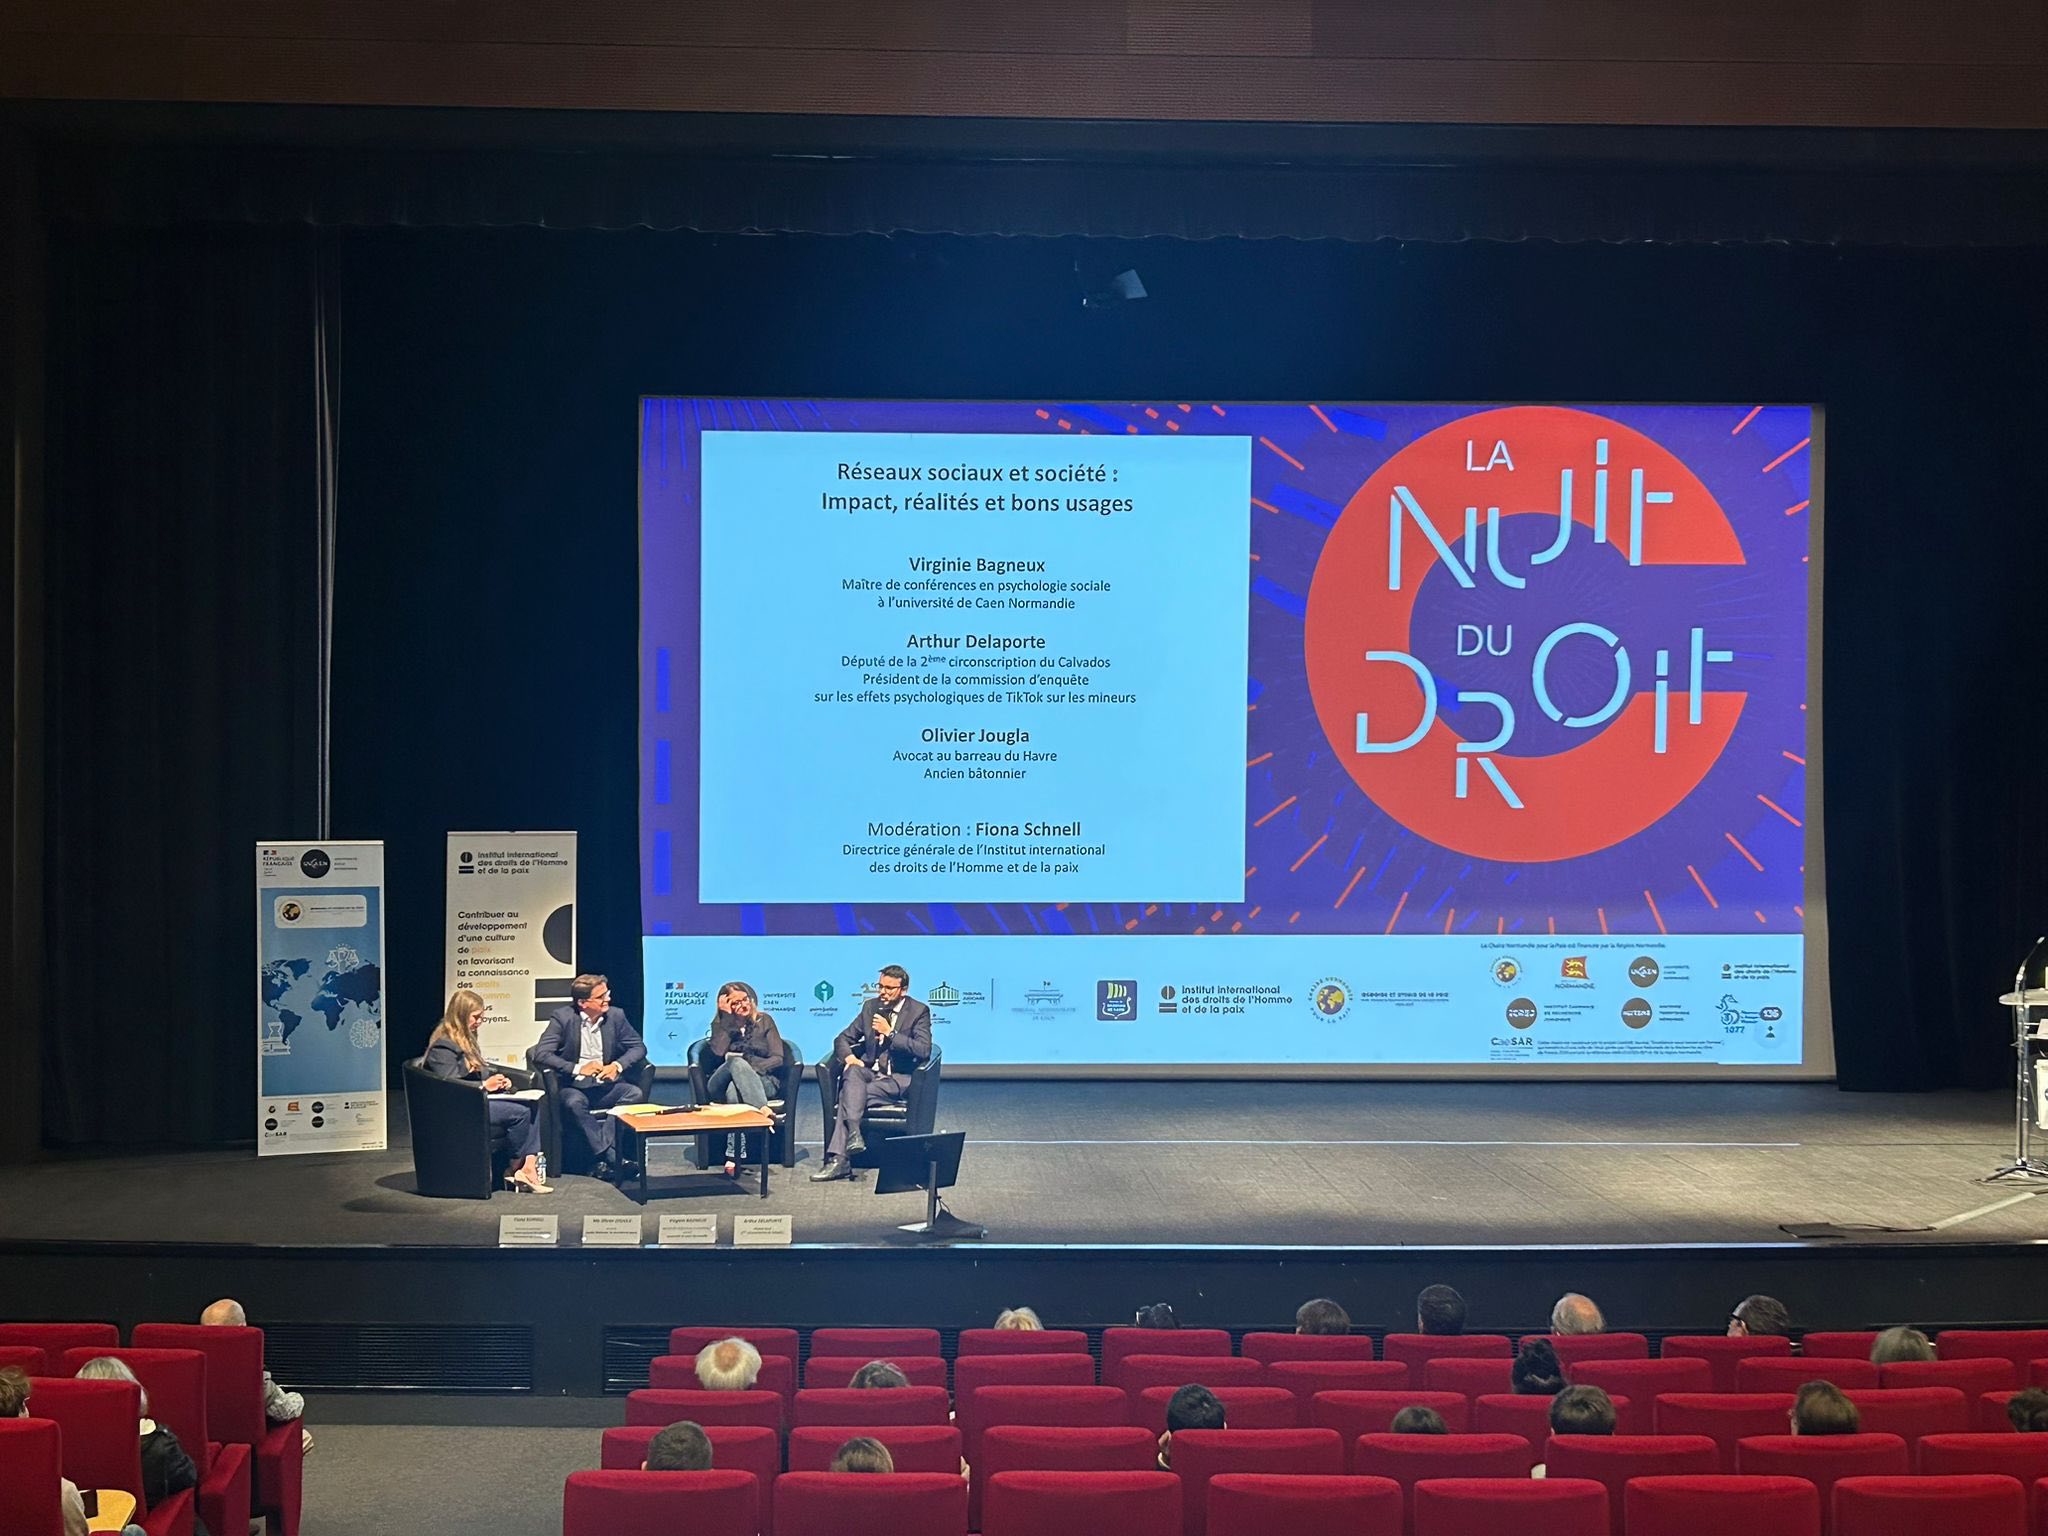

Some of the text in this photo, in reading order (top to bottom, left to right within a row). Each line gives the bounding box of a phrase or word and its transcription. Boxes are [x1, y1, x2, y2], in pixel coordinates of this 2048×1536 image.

[1466, 439, 1515, 472] LA
[837, 461, 923, 481] Réseaux
[927, 462, 1004, 483] sociaux
[1008, 465, 1030, 483] et
[1033, 463, 1107, 483] société
[821, 491, 1134, 516] Impact, réalités et bons usages
[908, 555, 1046, 576] Virginie Bagneux
[841, 577, 1111, 595] Maître de conférences en psychologie sociale
[877, 595, 885, 609] à
[956, 596, 973, 609] de
[975, 597, 1005, 609] Caen
[1008, 596, 1076, 610] Normandie
[906, 633, 1046, 653] Arthur Delaporte
[1456, 624, 1513, 656] DU
[841, 654, 886, 670] Député
[887, 655, 905, 668] de
[906, 655, 917, 668] la
[948, 655, 1037, 671] circonscription
[1039, 655, 1055, 668] du
[1057, 655, 1112, 669] Calvados
[863, 672, 921, 686] Président
[922, 673, 939, 686] de
[941, 672, 952, 686] la
[954, 673, 1026, 686] commission
[813, 690, 1137, 706] sur les effets psychologiques de TikTok sur les mineurs
[921, 727, 1030, 747] Olivier Jougla
[892, 749, 1058, 762] Avocat au barreau du Havre
[923, 766, 1027, 780] Ancien bâtonnier
[867, 820, 961, 837] Modération
[975, 821, 1020, 837] Fiona
[1023, 821, 1081, 837] Schnell
[841, 843, 901, 856] Directrice
[903, 843, 956, 859] générale
[957, 843, 974, 856] de
[1028, 843, 1106, 856] international
[869, 860, 891, 873] des
[893, 860, 929, 873] droits
[930, 860, 947, 873] de
[1006, 863, 1020, 873] et
[1022, 860, 1038, 873] de
[1040, 860, 1051, 873] la
[1053, 861, 1081, 876] paix
[457, 911, 505, 919] Contribuer
[457, 921, 528, 931] développement
[485, 933, 516, 942] culture
[457, 946, 470, 954] de
[470, 957, 515, 965] favorisant
[456, 968, 530, 977] la connaissance
[457, 981, 473, 989] des
[1181, 985, 1281, 995] Institut international
[1181, 995, 1293, 1004] des droits de l'Homme
[1193, 1004, 1207, 1014] de
[1209, 1004, 1220, 1014] la
[1221, 1004, 1245, 1015] paix
